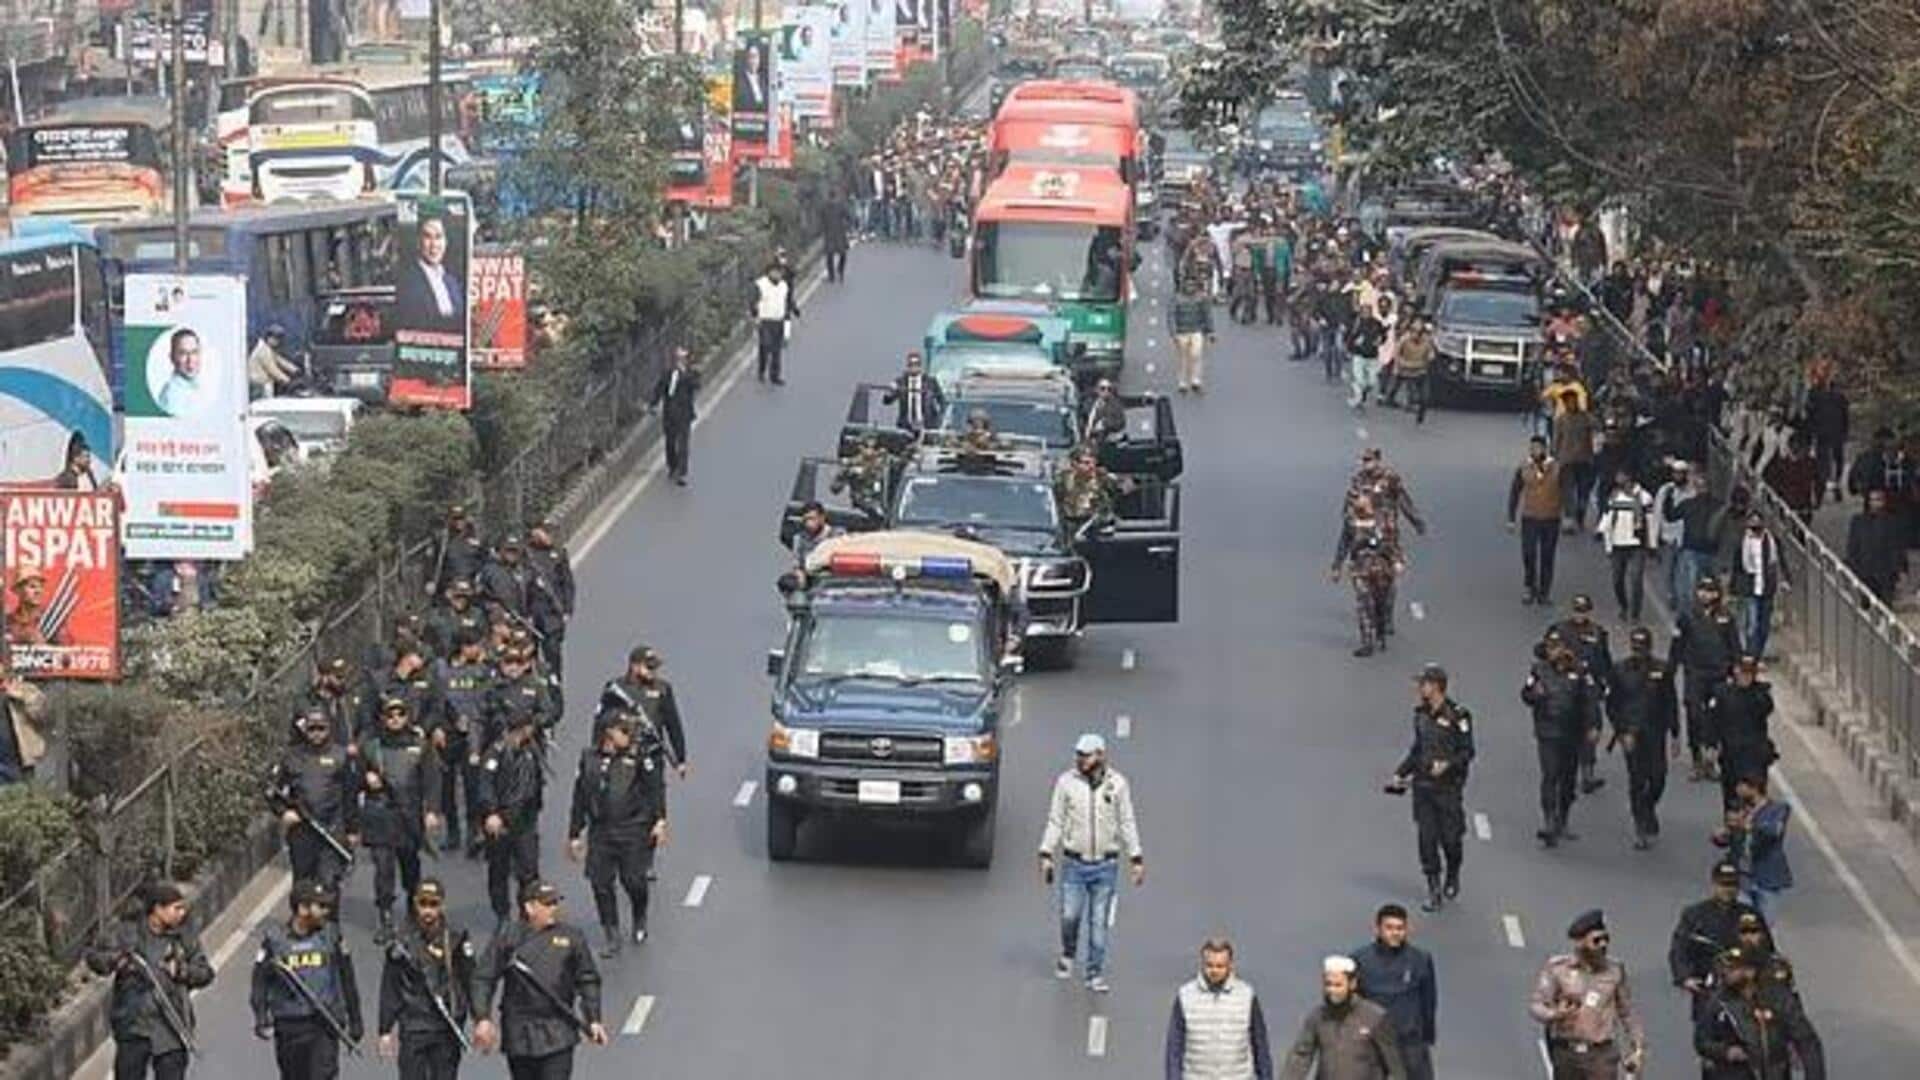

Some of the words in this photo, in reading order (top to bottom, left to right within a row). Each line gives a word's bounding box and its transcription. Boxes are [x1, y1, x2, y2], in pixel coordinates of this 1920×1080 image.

[471, 257, 524, 275] NWAR
[471, 275, 524, 301] SPAT
[7, 496, 114, 527] ANWAR
[6, 528, 113, 570] ISPAT
